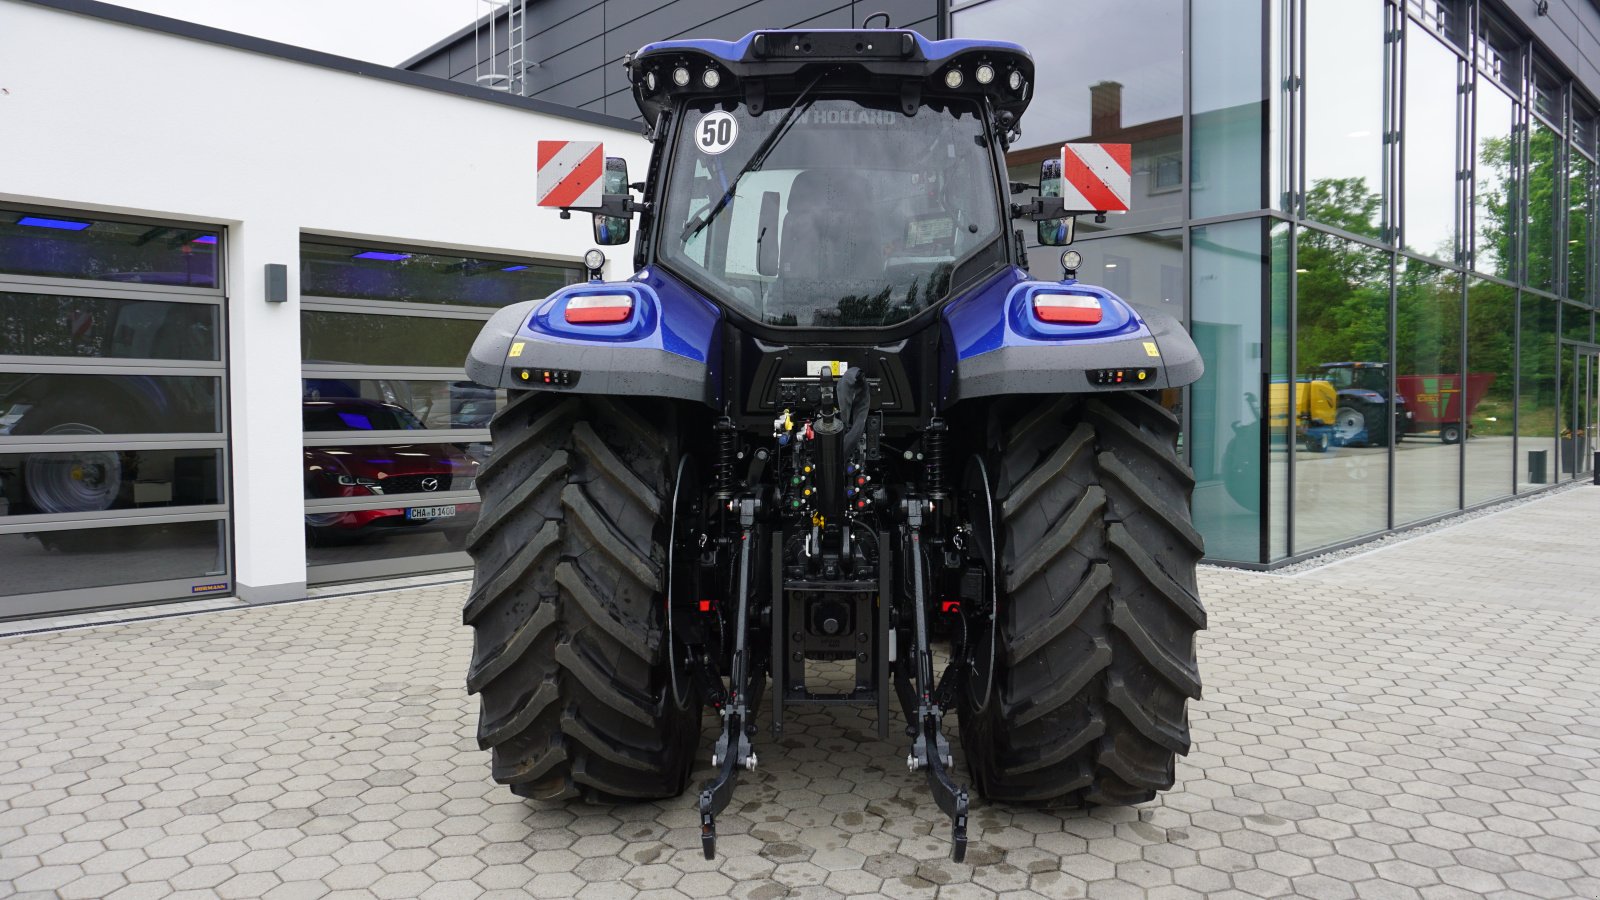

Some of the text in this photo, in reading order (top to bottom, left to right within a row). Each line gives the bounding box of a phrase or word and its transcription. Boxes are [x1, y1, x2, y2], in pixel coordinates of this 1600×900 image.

[768, 109, 896, 125] NW HOLLAND
[702, 118, 731, 147] 50
[411, 508, 426, 517] CHA
